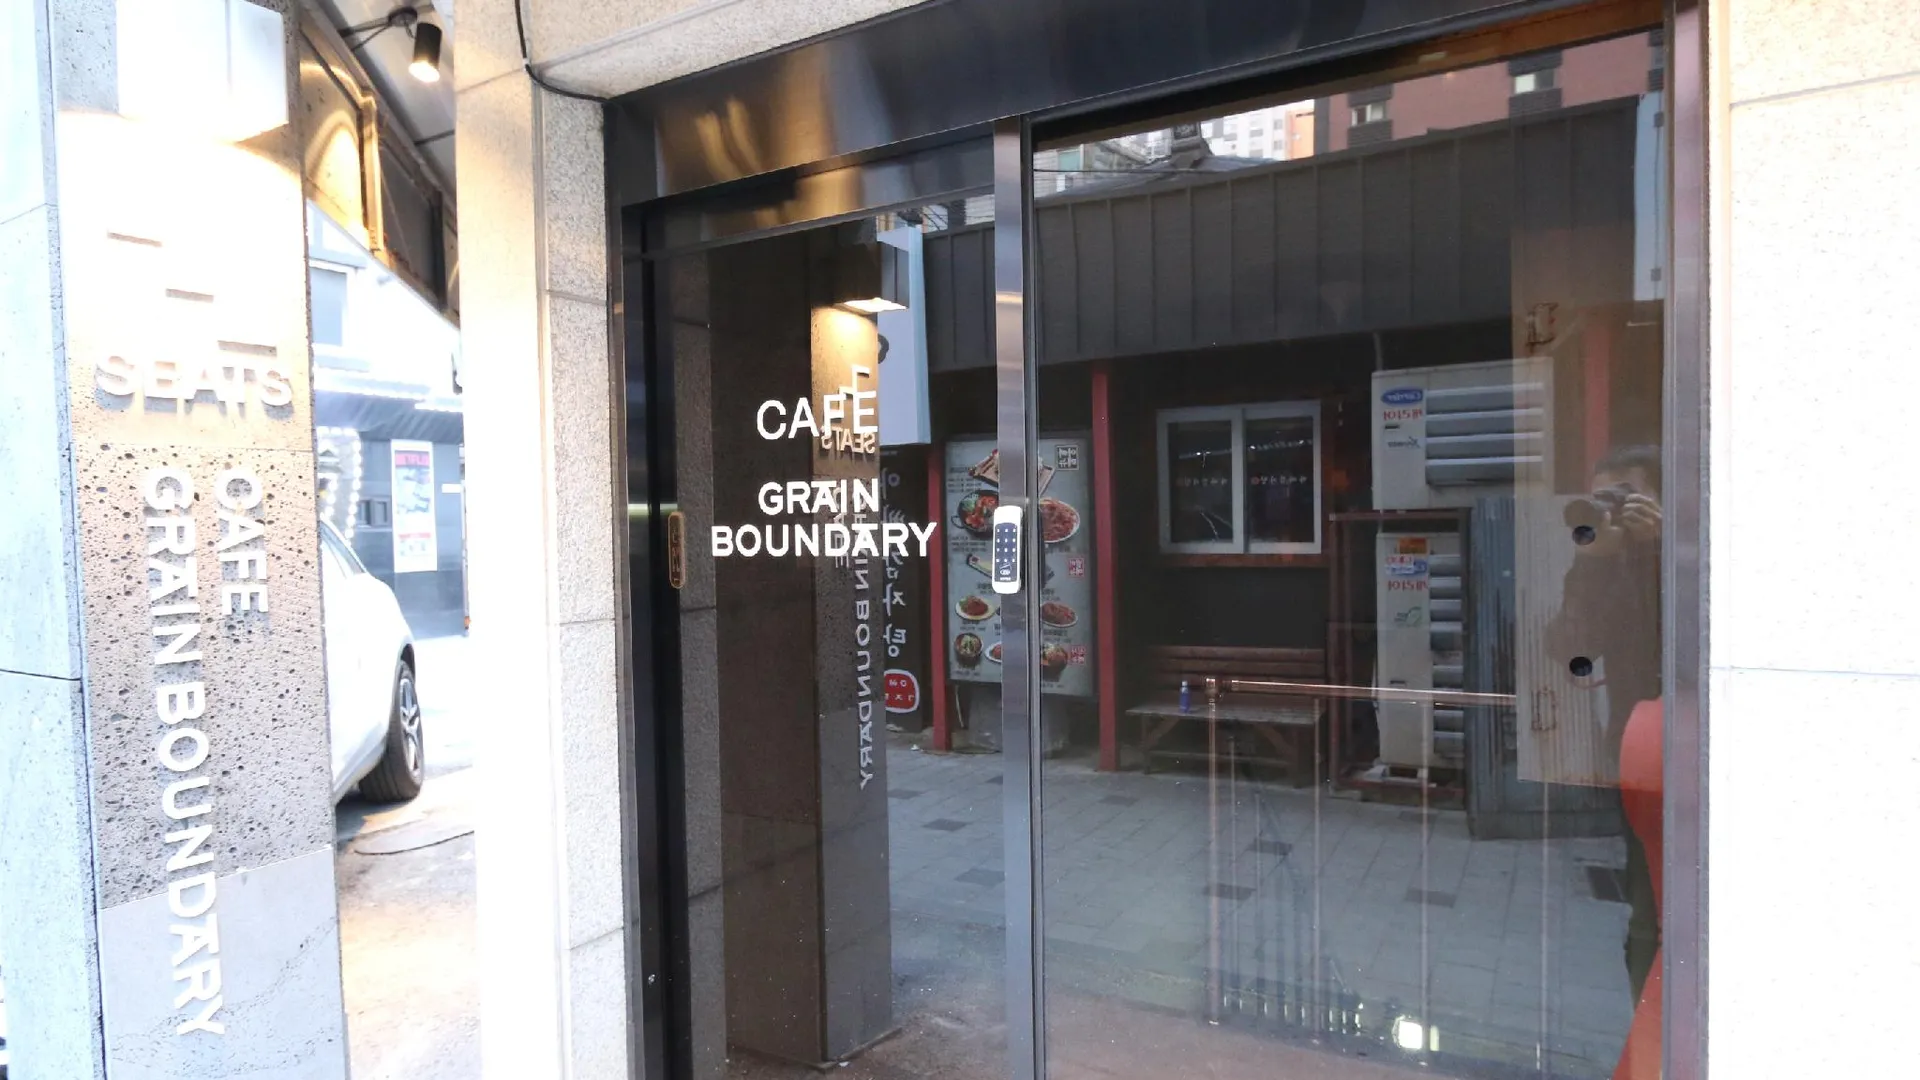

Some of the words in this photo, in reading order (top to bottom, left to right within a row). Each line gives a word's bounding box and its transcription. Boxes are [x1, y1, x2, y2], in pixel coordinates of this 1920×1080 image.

[94, 351, 292, 407] SEATS
[756, 389, 878, 441] CAFE
[758, 480, 880, 515] GRAIN
[144, 467, 203, 665] GRAIN
[214, 467, 270, 615] CAFE
[711, 522, 937, 557] BOUNDARY
[156, 681, 226, 1036] BOUNDARY
